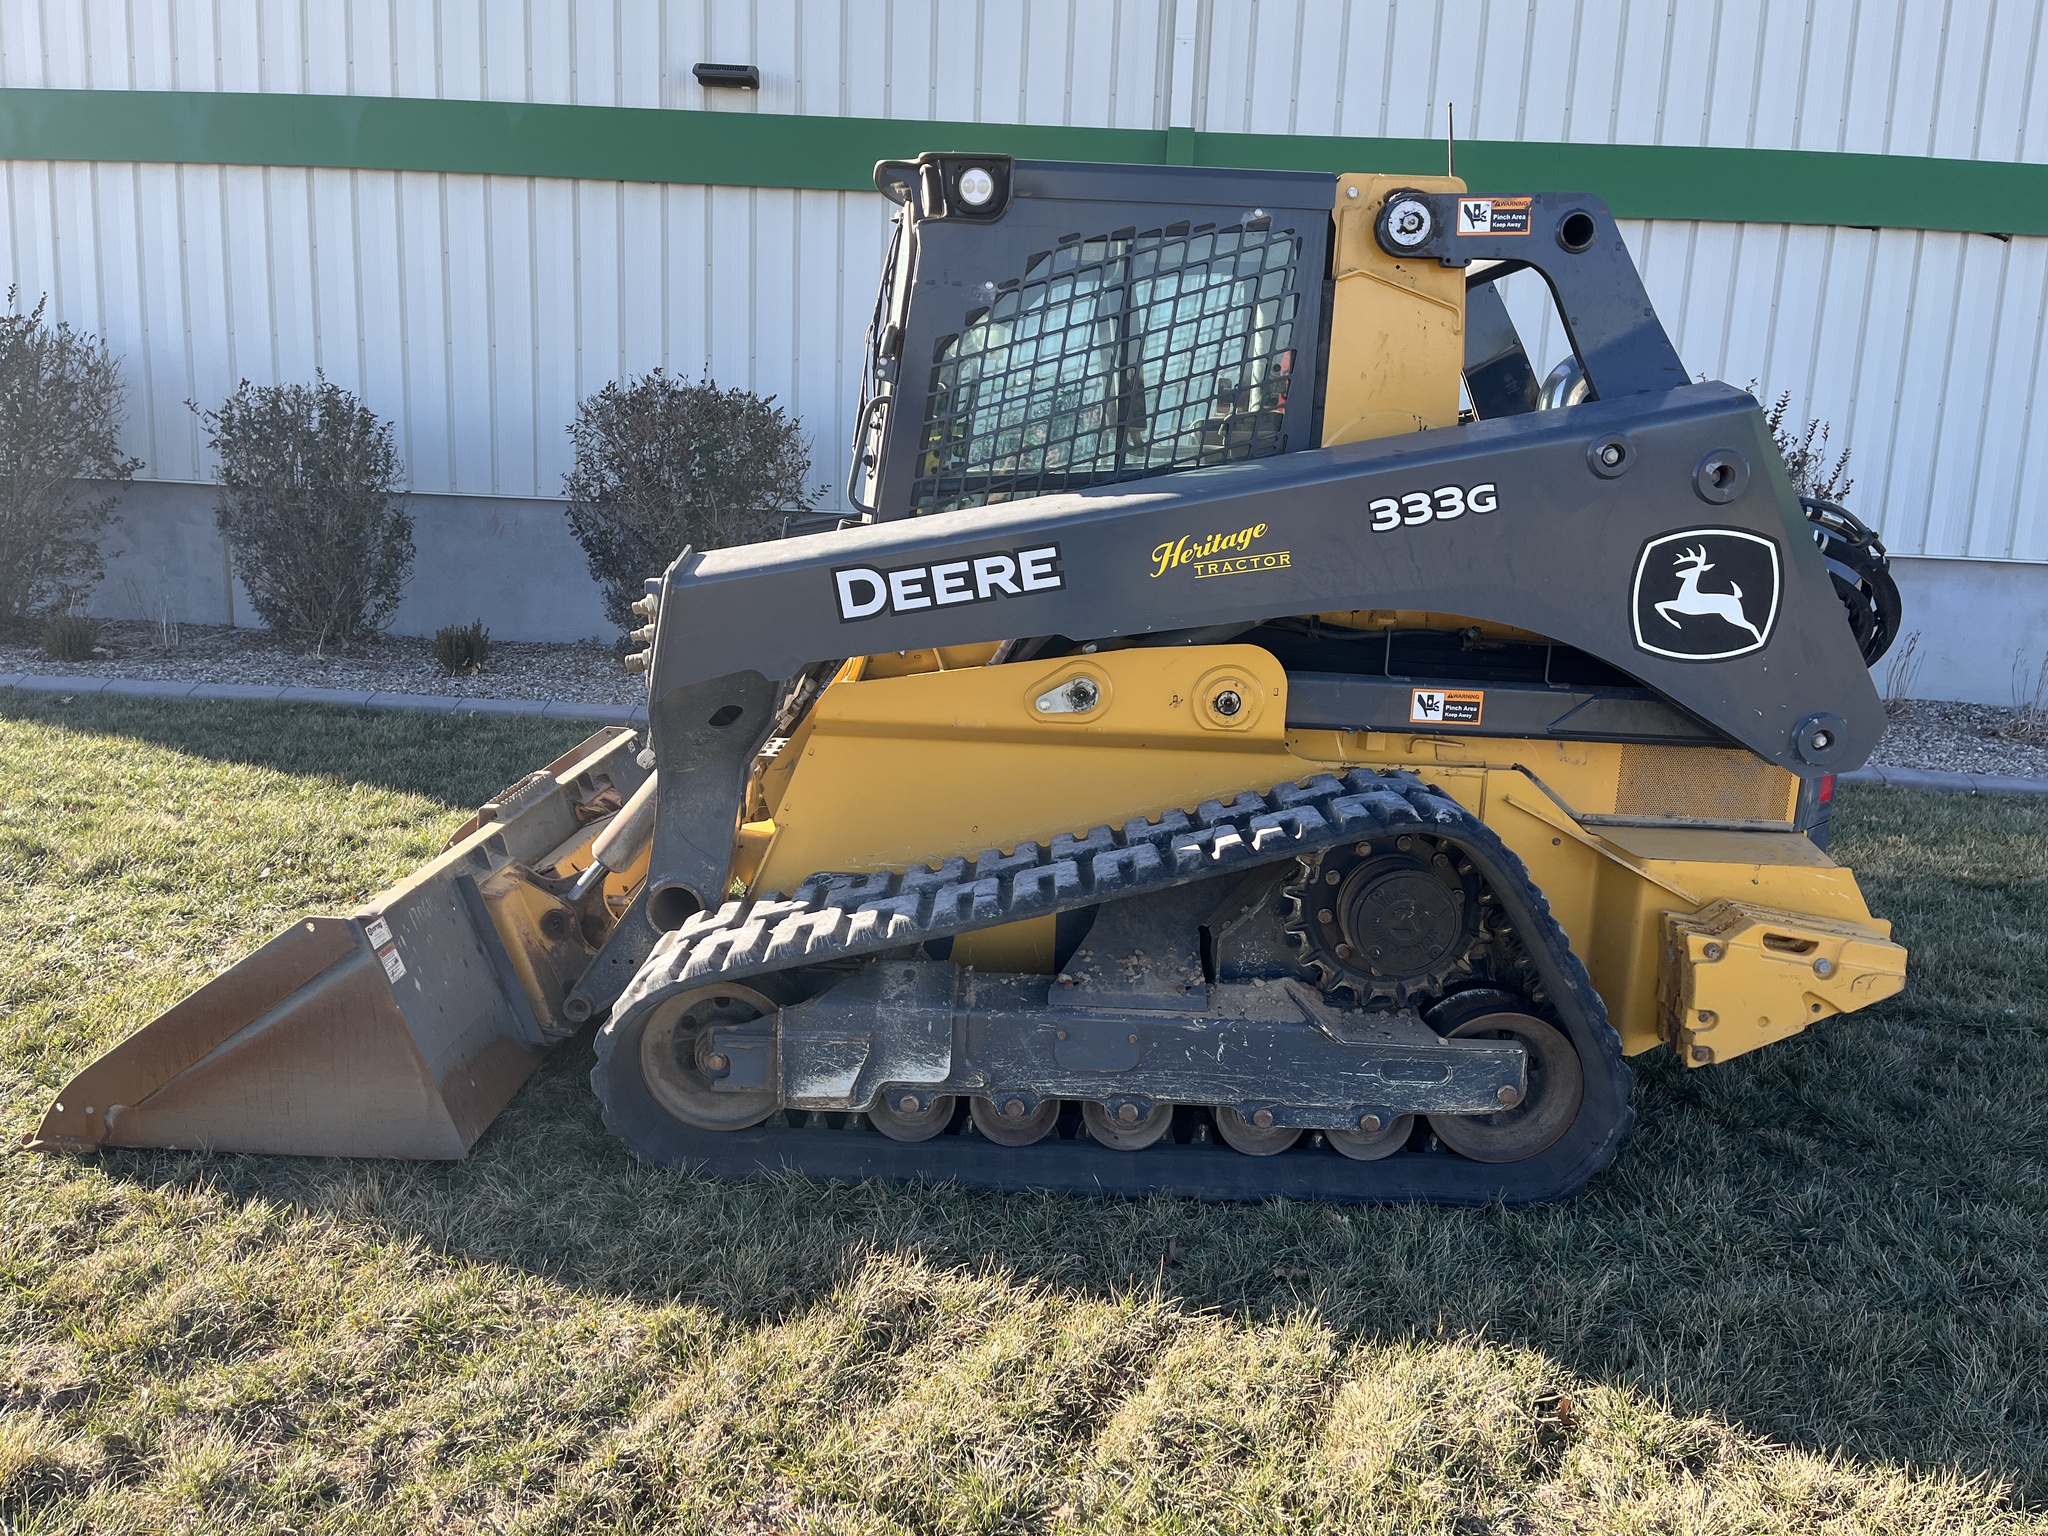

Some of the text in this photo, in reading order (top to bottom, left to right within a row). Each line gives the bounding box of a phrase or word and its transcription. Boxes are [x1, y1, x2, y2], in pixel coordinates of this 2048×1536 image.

[1369, 484, 1497, 531] 333G
[1150, 522, 1269, 578] Heritage
[1193, 554, 1291, 576] TRACTOR
[835, 546, 1061, 619] DEERE
